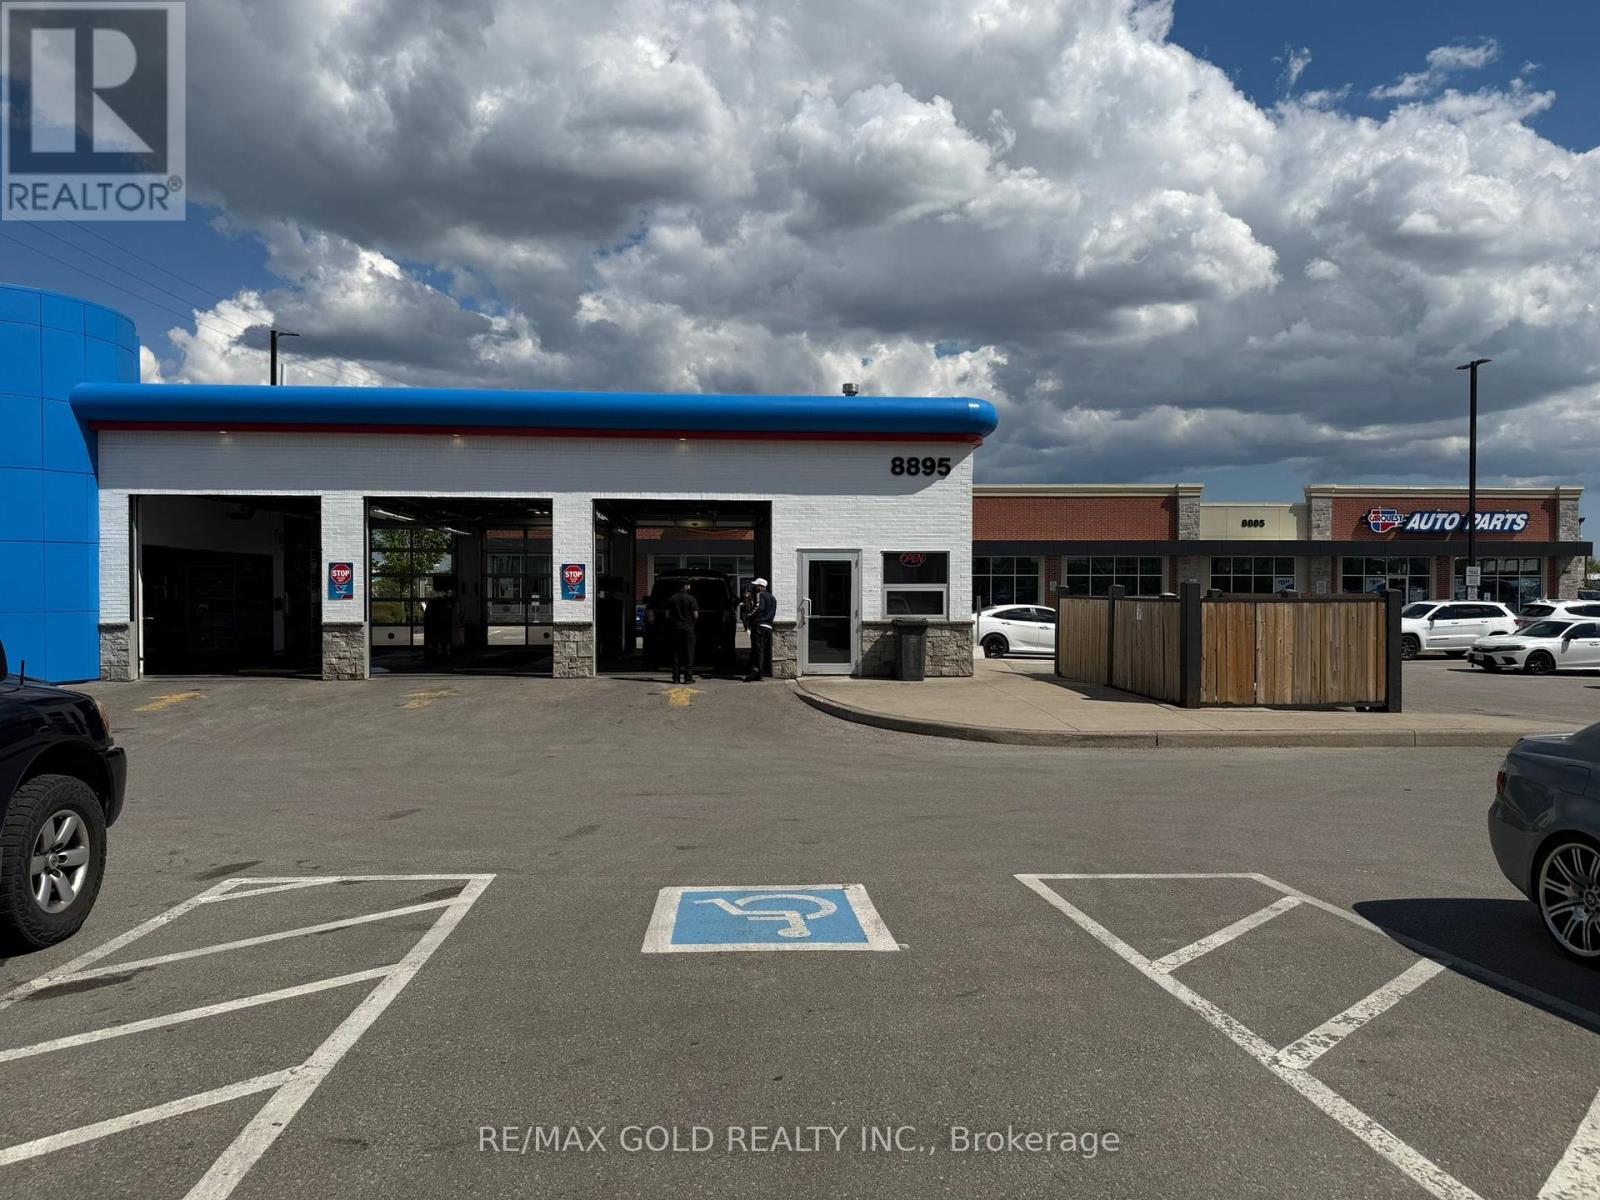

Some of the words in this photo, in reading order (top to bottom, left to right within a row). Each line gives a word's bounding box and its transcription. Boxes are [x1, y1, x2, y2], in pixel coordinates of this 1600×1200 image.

[891, 456, 952, 476] 8895
[1241, 519, 1265, 528] 8885
[1369, 514, 1404, 523] CARQUEST
[1406, 513, 1460, 530] AUTO
[1466, 513, 1528, 530] PARTS
